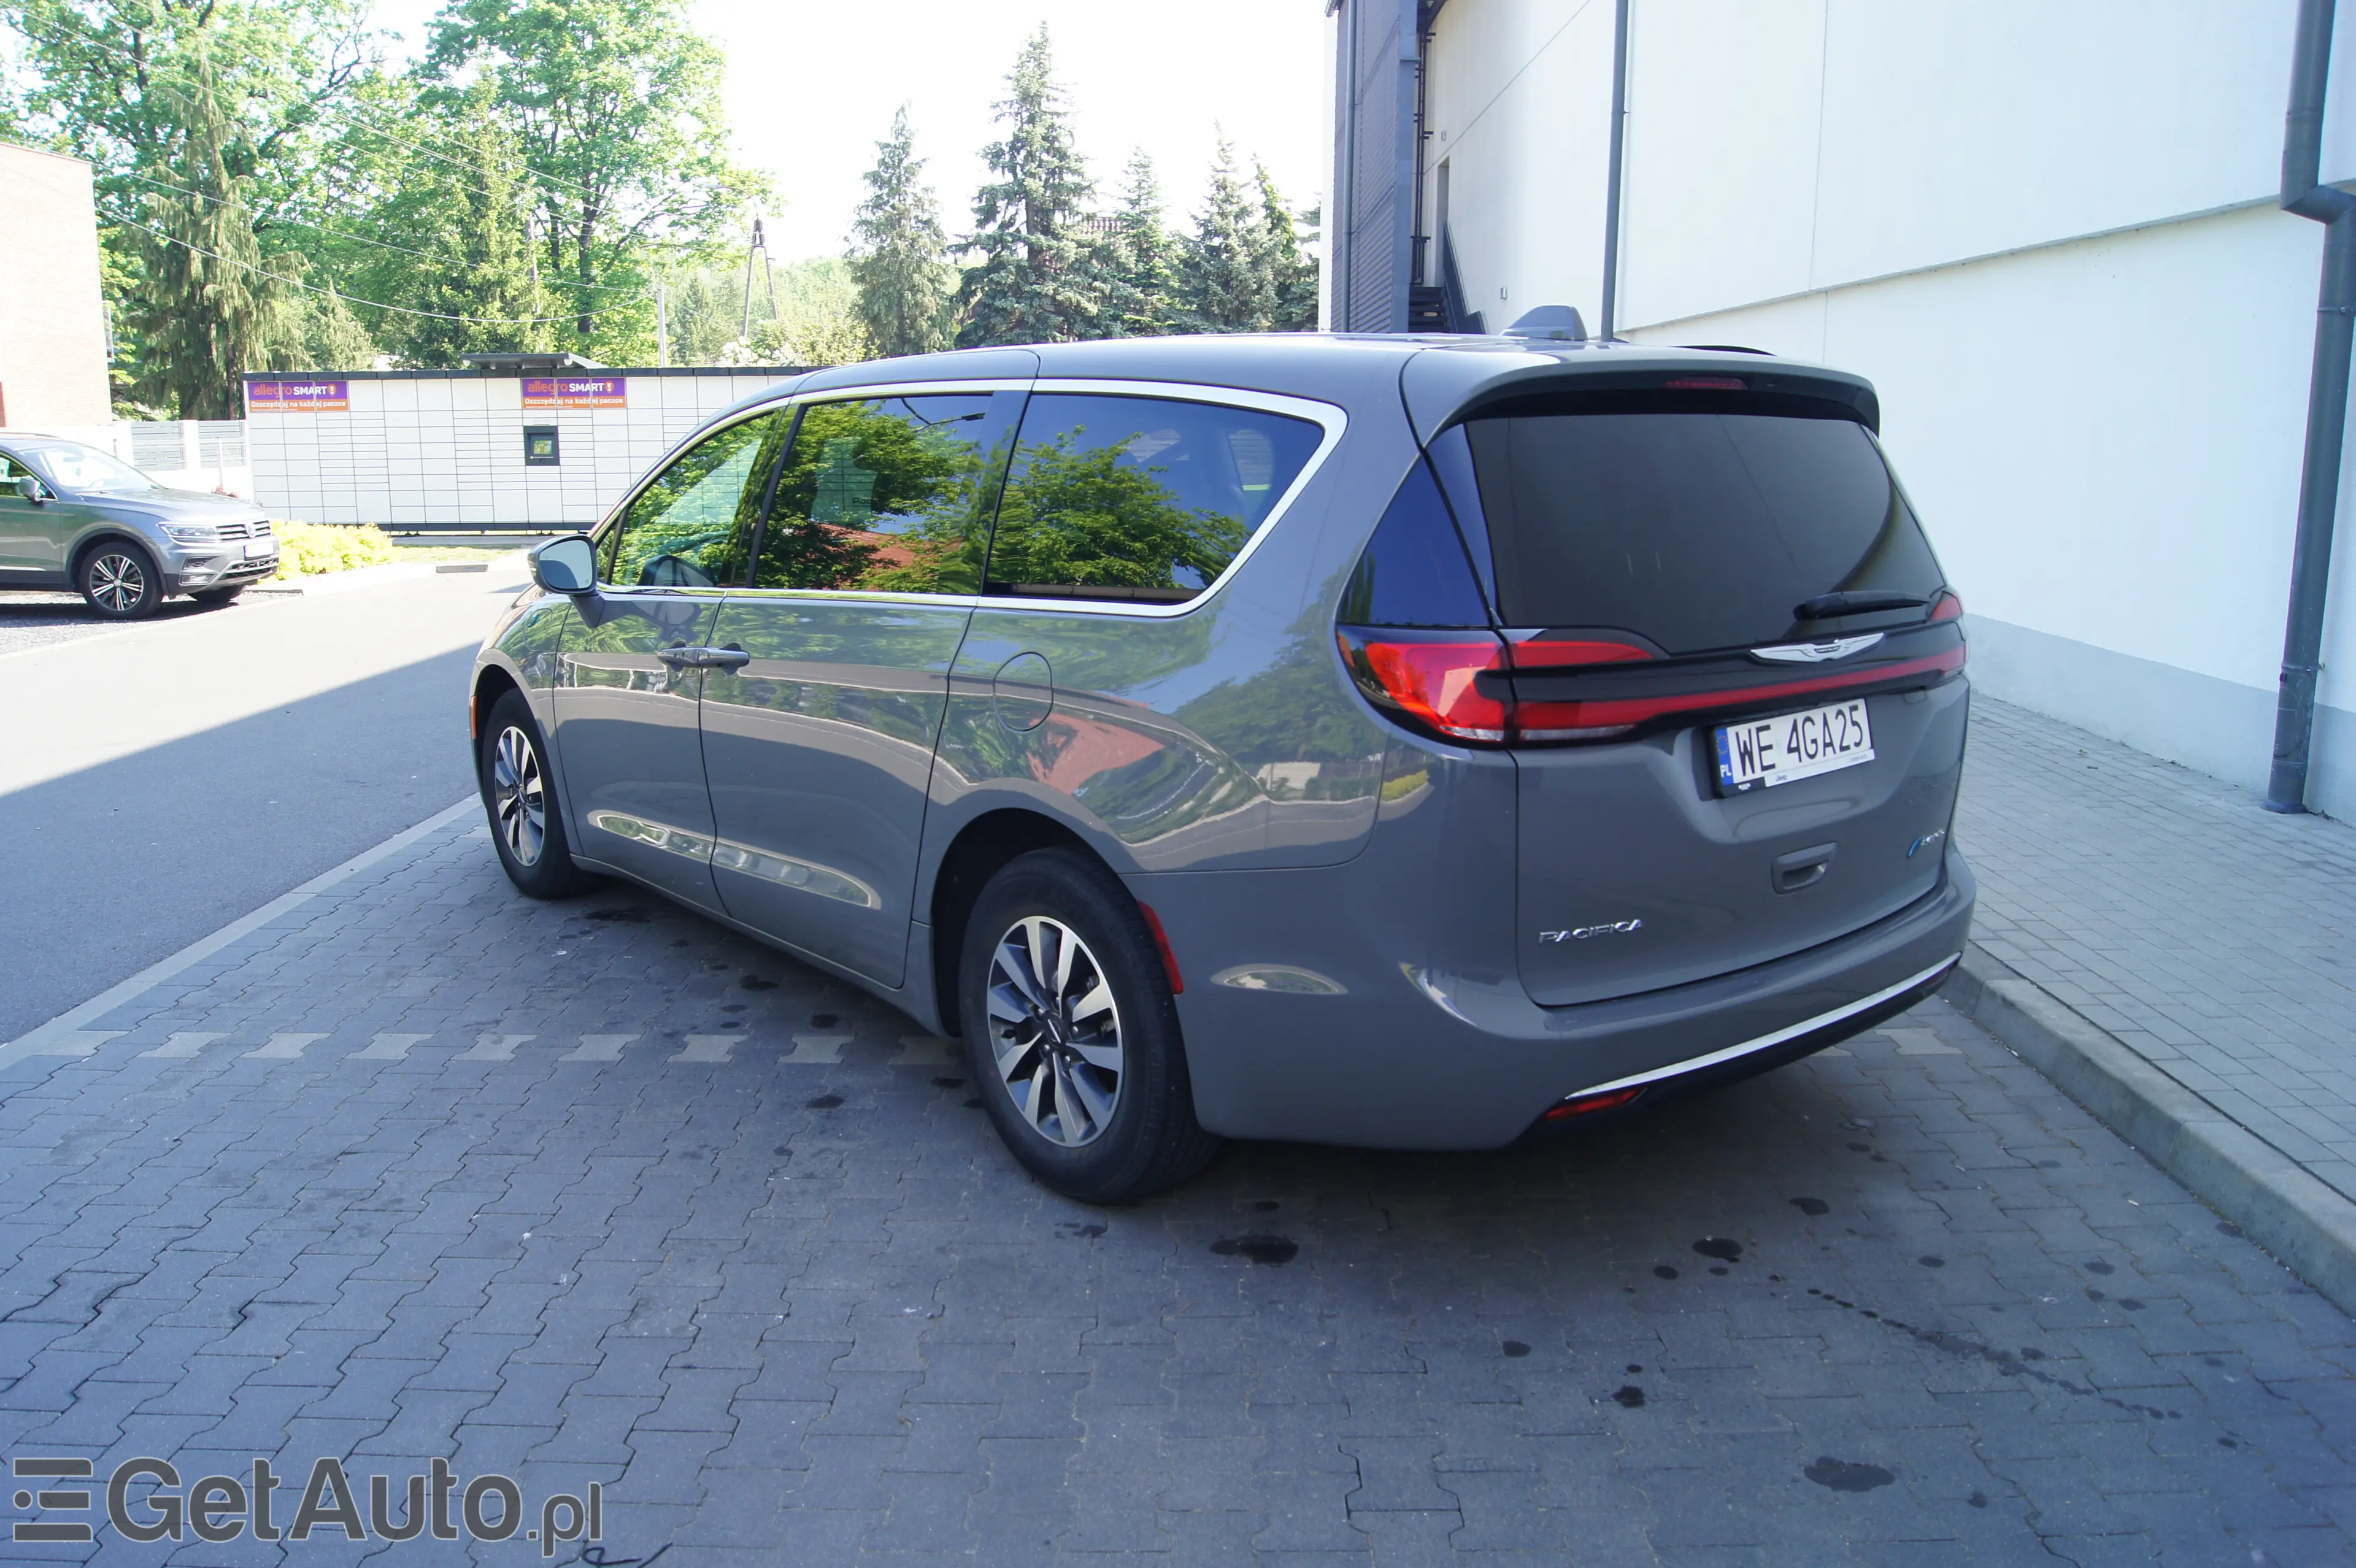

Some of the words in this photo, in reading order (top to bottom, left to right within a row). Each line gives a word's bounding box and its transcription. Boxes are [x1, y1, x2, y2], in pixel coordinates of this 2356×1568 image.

[1735, 724, 1776, 776] WE
[1787, 704, 1863, 763] 4GA25
[1720, 764, 1731, 777] PL
[1539, 919, 1642, 943] PACIFICA
